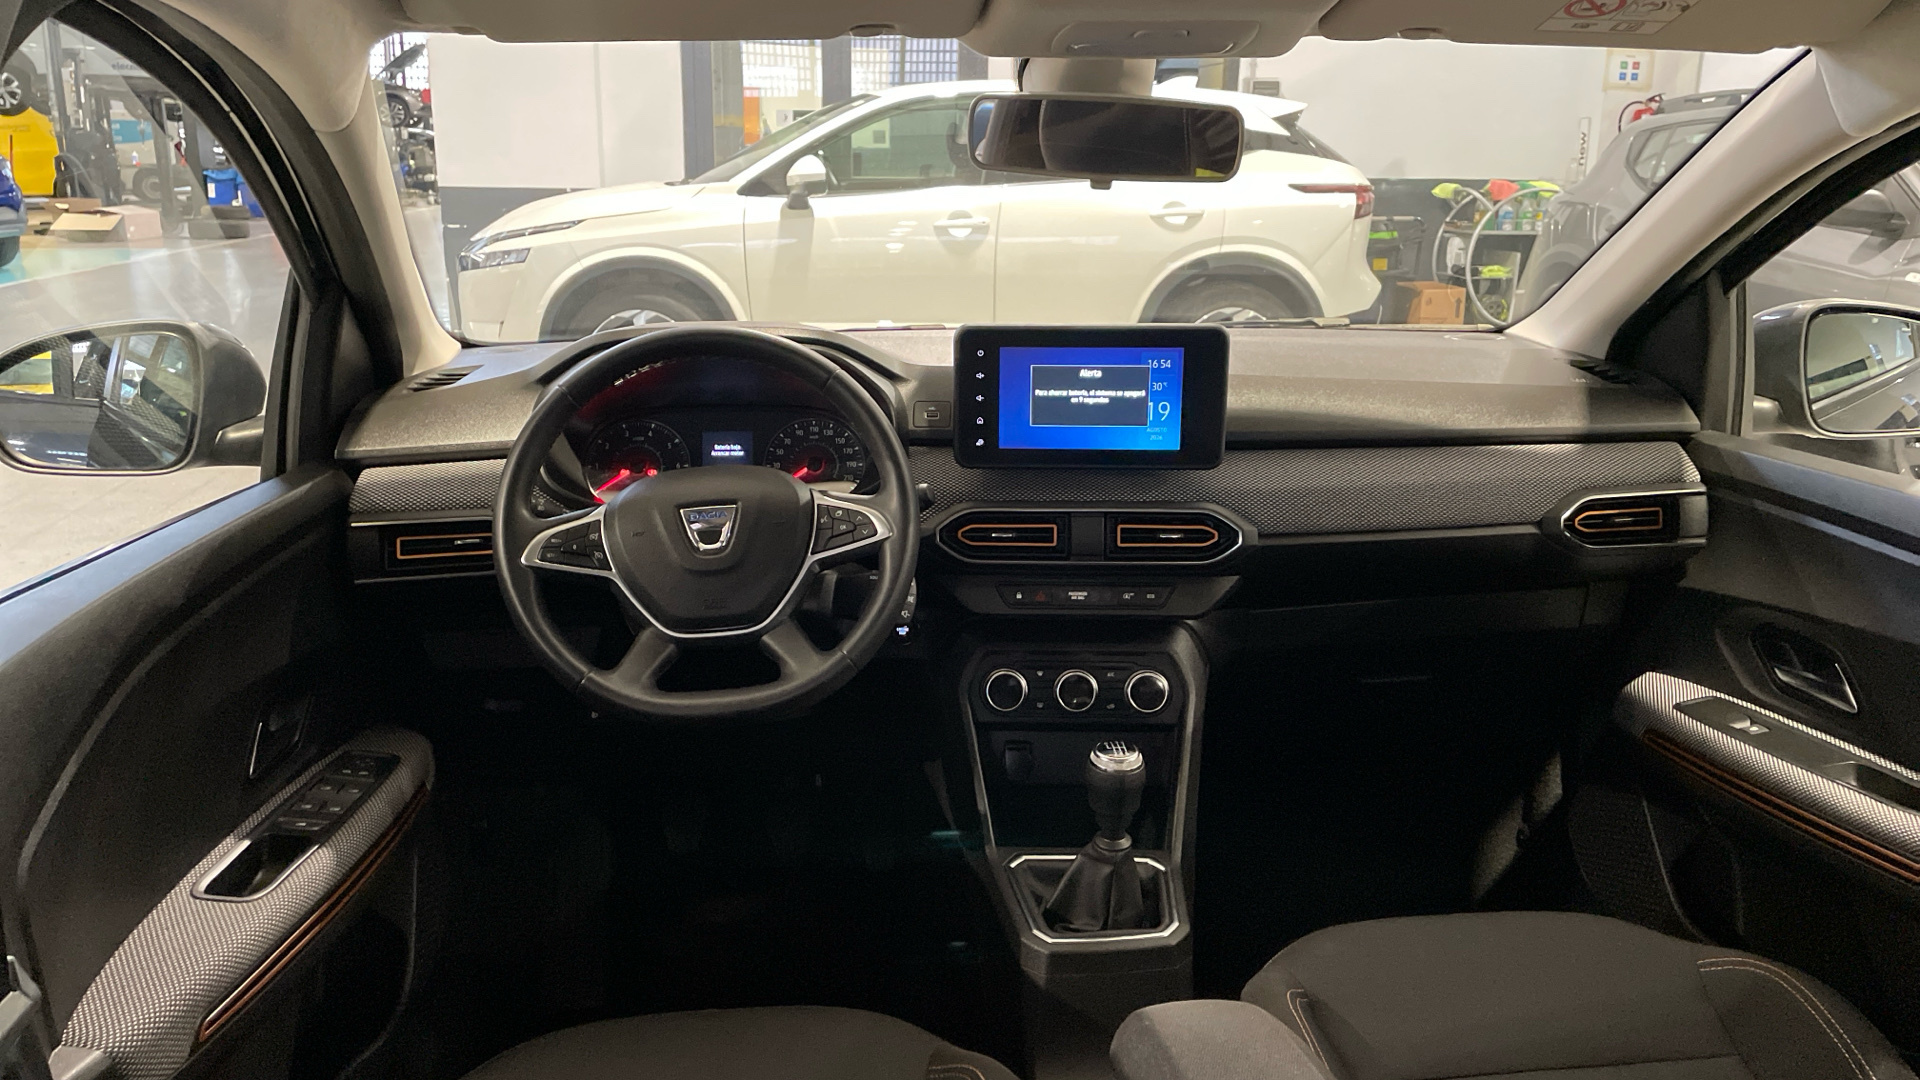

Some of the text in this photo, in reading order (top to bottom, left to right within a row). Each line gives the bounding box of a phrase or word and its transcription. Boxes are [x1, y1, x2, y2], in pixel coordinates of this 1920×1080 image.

[1160, 359, 1171, 369] 54
[1079, 369, 1102, 378] Alerta
[1148, 401, 1170, 421] 19
[688, 511, 728, 521] DACIA
